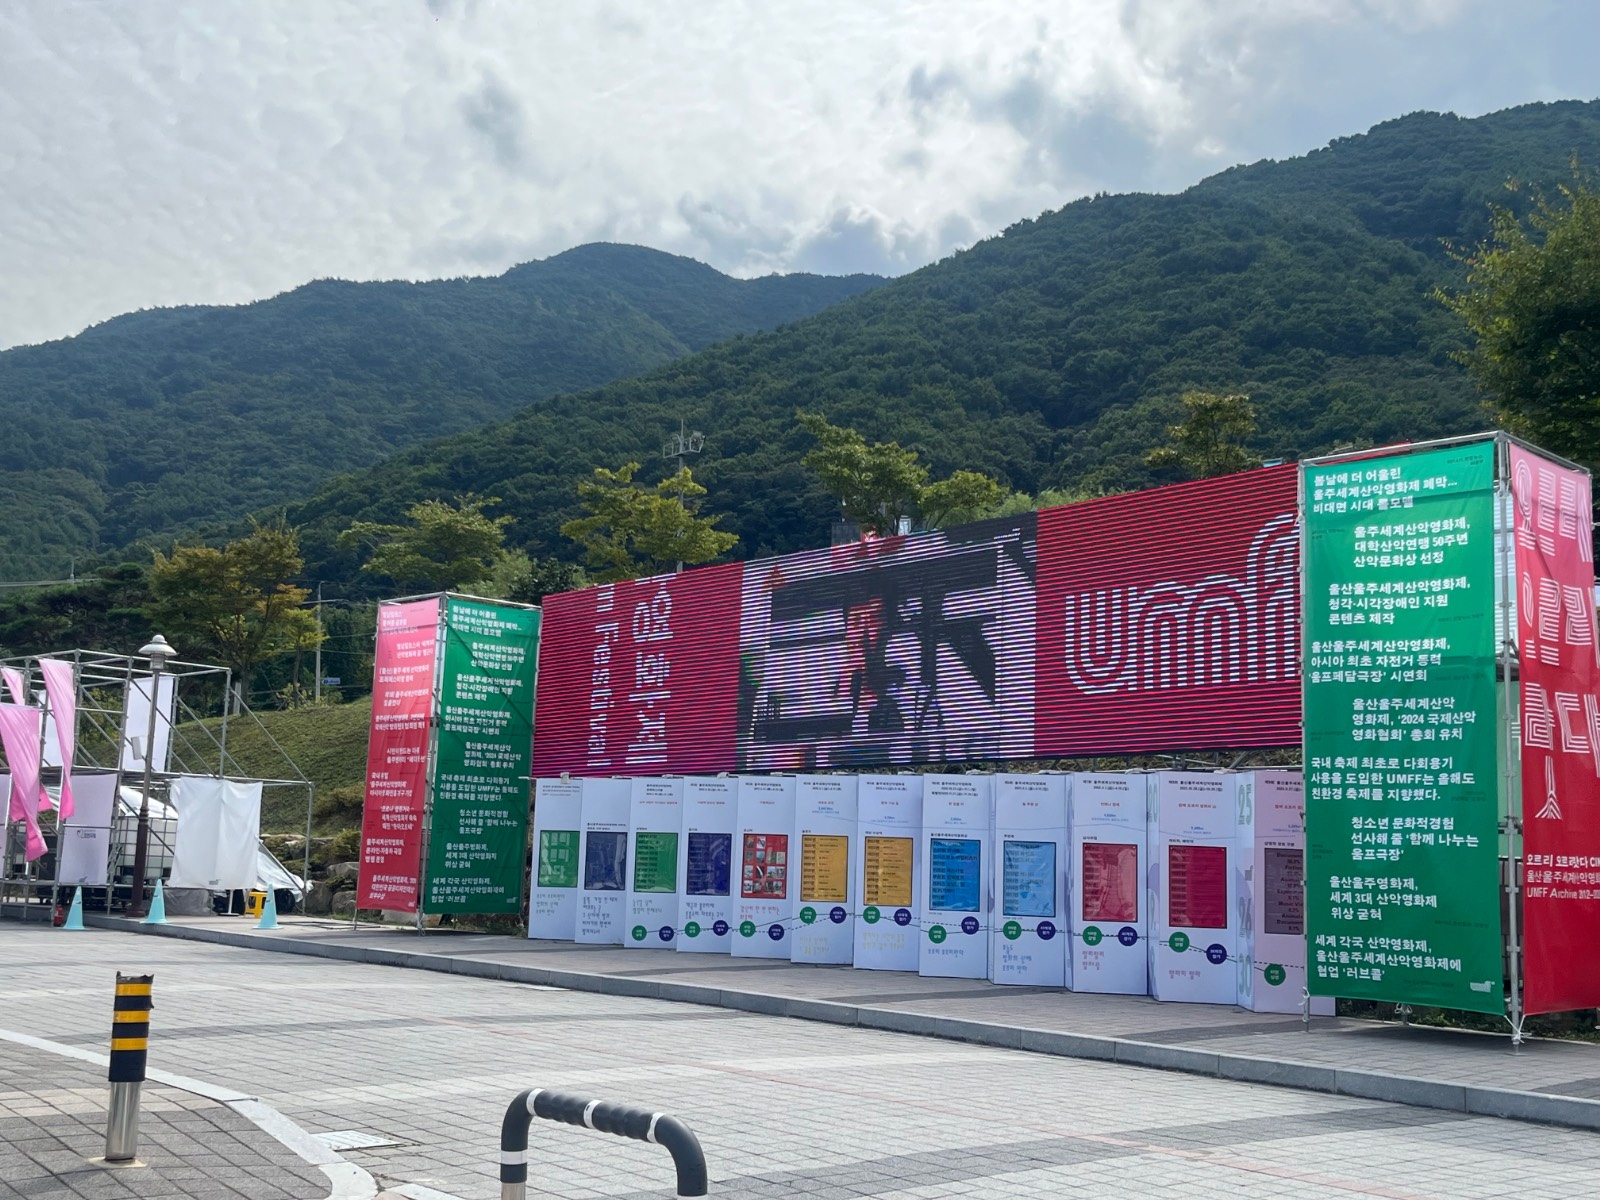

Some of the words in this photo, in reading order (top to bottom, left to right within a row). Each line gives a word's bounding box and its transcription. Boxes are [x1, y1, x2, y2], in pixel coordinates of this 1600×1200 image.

[1314, 473, 1348, 487] 봄날에
[1351, 472, 1362, 483] 더
[1366, 467, 1400, 481] 어울린
[1314, 481, 1420, 500] 울주세계산악영화제
[1314, 501, 1347, 514] 비대면
[1350, 499, 1374, 511] 시대
[1377, 496, 1413, 510] 롤모델
[1354, 517, 1471, 540] 울주세계산악영화제,
[1355, 537, 1430, 552] 대학산악연맹
[1432, 534, 1468, 547] 50주년
[1354, 553, 1417, 567] 산악문화상
[1420, 551, 1443, 564] 선정
[1329, 576, 1471, 595] 울산울주세계산악영화제,
[1329, 597, 1419, 610] 청각·시각장애인
[1424, 594, 1448, 607] 지원
[1329, 613, 1365, 625] 콘텐츠
[1369, 613, 1395, 624] 제작
[1312, 638, 1451, 653] 울산울주세계산악영화제,
[1311, 655, 1344, 668] 아시아
[1347, 655, 1372, 667] 최초
[1376, 655, 1413, 667] 자전거
[1417, 653, 1441, 666] 동력
[1390, 670, 1426, 682] 시연회
[1353, 697, 1455, 710] 울산울주세계산악
[1352, 713, 1394, 726] 영화제,
[1427, 711, 1476, 725] 국제산악
[1410, 729, 1435, 741] 총회
[1439, 728, 1462, 740] 유치
[1311, 757, 1331, 768] 국내
[1334, 757, 1357, 769] 축제
[1361, 757, 1400, 769] 최초로
[1404, 757, 1452, 770] 다회용기
[1311, 772, 1342, 784] 사용을
[1345, 773, 1383, 785] 도입한
[1387, 774, 1434, 785] UMFF는
[1438, 772, 1475, 785] 올해도
[1312, 788, 1342, 800] 친환경
[1346, 788, 1383, 800] 축제를
[1387, 789, 1441, 801] 지향했다.
[1352, 817, 1388, 829] 청소년
[1392, 817, 1453, 830] 문화적경험
[1351, 832, 1387, 845] 선사해
[1391, 833, 1403, 845] 줄
[1439, 833, 1479, 847] 나누는
[1526, 854, 1554, 867] 오르리
[1330, 876, 1419, 890] 울산울주영화제,
[1527, 870, 1600, 884] 울산울주세계산악영화
[1330, 891, 1352, 904] 세계
[1355, 893, 1372, 904] 3대
[1377, 893, 1437, 908] 산악영화제
[1331, 907, 1354, 920] 위상
[1357, 908, 1381, 920] 굳혀
[1315, 935, 1336, 947] 세계
[1340, 936, 1363, 948] 각국
[1367, 937, 1432, 953] 산악영화제,
[1316, 949, 1461, 973] 울산울주세계산악영화제에
[1317, 965, 1339, 978] 협업
